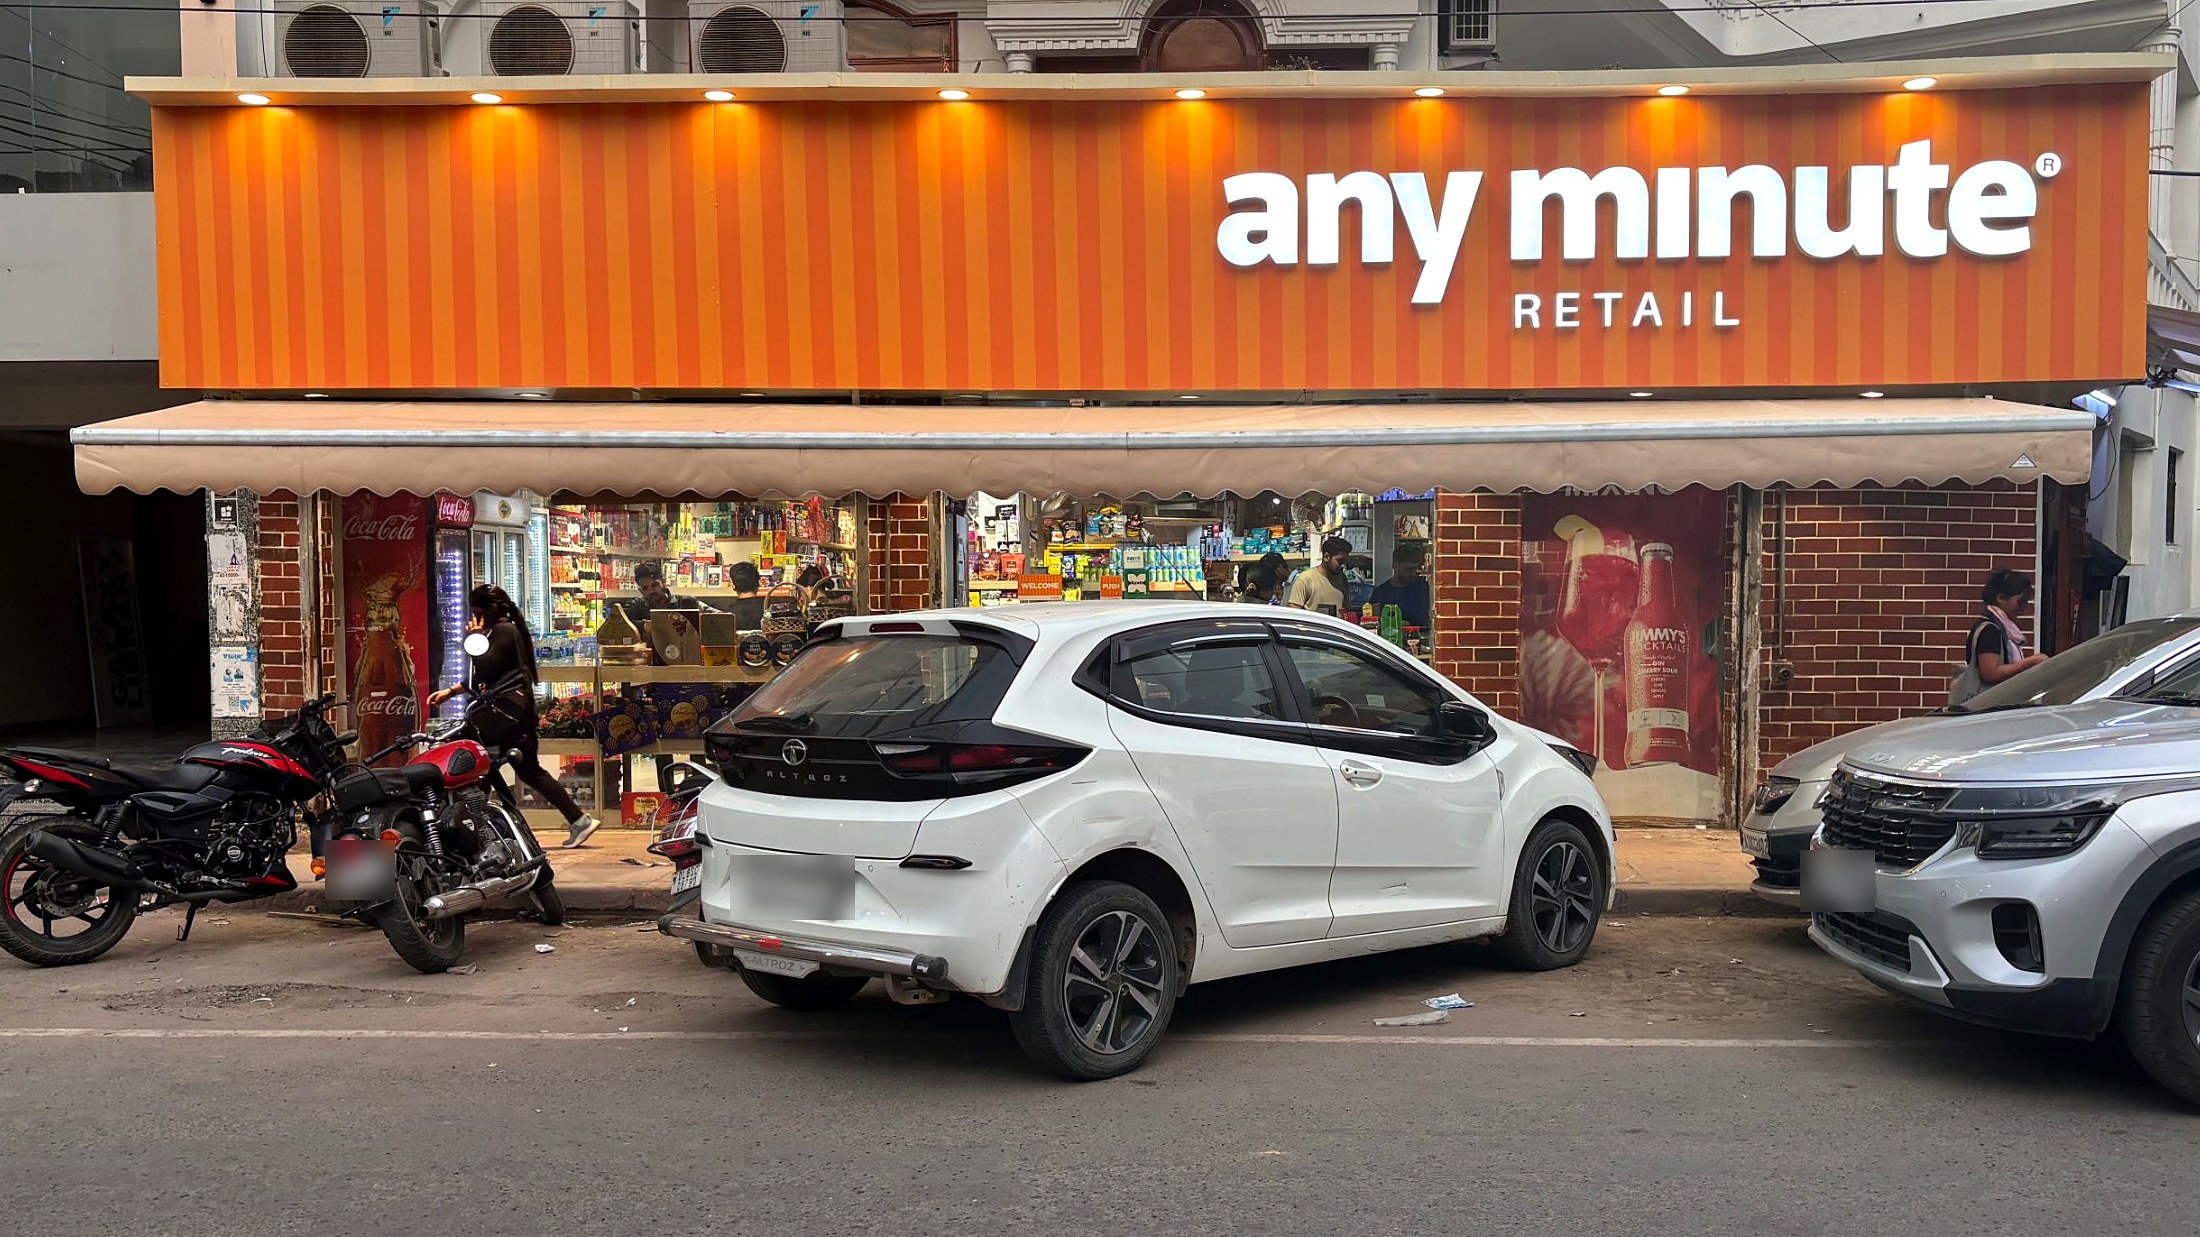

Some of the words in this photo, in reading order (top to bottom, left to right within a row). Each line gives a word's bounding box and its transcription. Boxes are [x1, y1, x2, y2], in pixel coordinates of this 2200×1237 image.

[1217, 171, 1484, 303] any
[1511, 139, 2037, 258] minute
[1514, 291, 1740, 328] RETAIL
[343, 513, 418, 541] Coca-Cola
[766, 770, 848, 783] ALTROZ
[752, 955, 795, 972] ALTROZ
